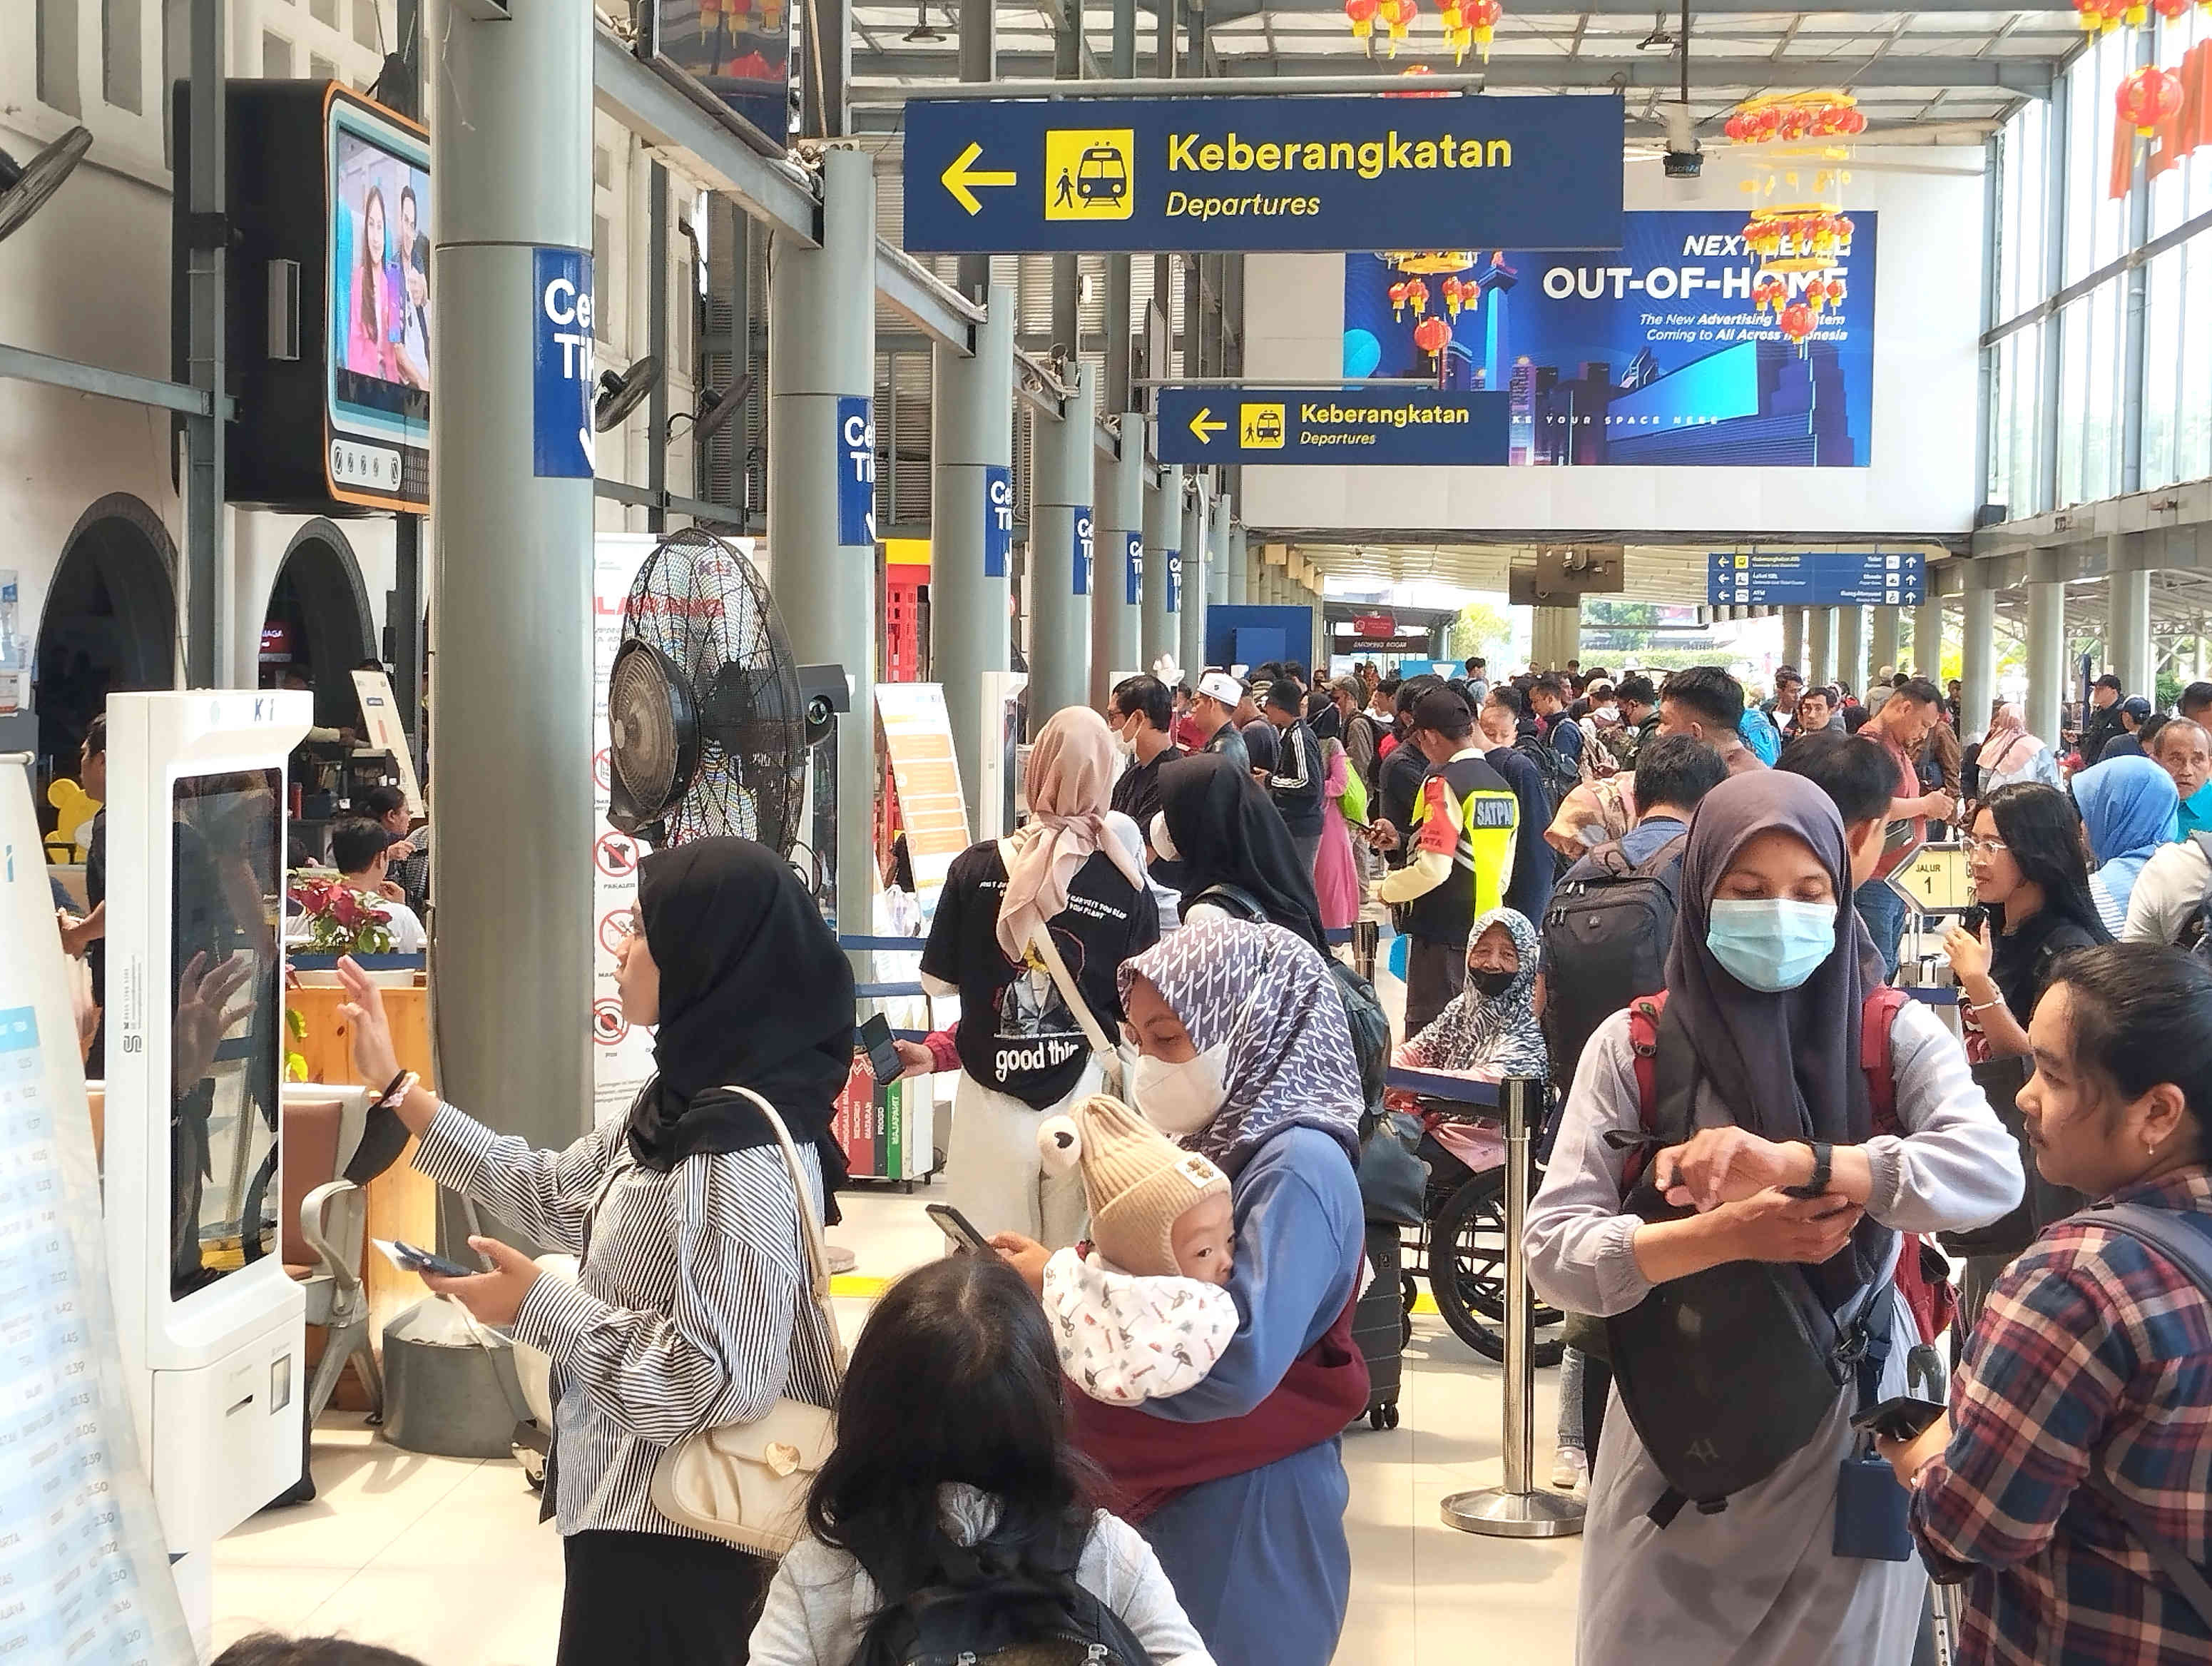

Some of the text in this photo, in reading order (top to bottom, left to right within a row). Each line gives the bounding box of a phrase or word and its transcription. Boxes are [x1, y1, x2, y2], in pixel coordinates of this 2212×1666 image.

[1168, 131, 1512, 180] Keberangkatan
[1166, 191, 1321, 223] Departures
[1683, 235, 1753, 256] NEXT
[1542, 267, 1849, 300] OUT-OF-HOME
[544, 278, 593, 330] Ce
[1640, 313, 1663, 325] The
[1666, 314, 1696, 325] New
[1697, 313, 1773, 327] Advertising
[1646, 329, 1696, 342] Coming
[1699, 329, 1713, 340] to
[1715, 328, 1736, 340] All
[1736, 328, 1782, 340] Across
[1301, 403, 1469, 427] Keberangkatan
[1546, 416, 1592, 425] YOUR
[1604, 416, 1660, 425] SPACE
[1300, 431, 1377, 447] Departures
[1915, 863, 1941, 873] JALUR
[1924, 876, 1932, 894] 1
[995, 1041, 1045, 1083] good
